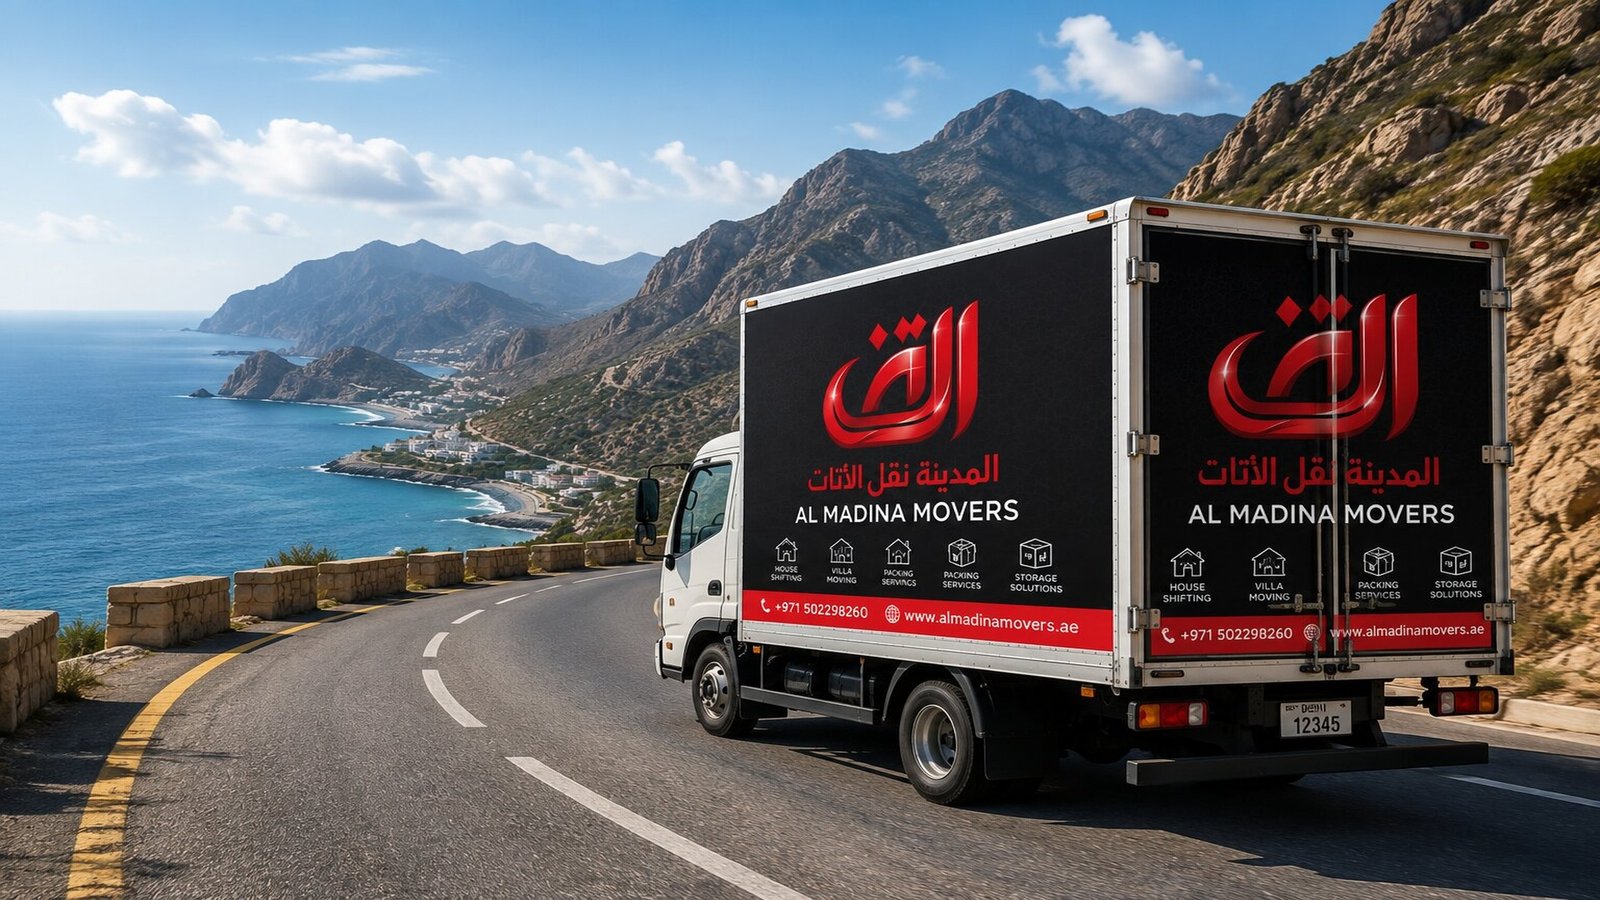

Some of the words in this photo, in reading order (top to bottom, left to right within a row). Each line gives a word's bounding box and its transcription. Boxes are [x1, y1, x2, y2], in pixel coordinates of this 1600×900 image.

[916, 453, 999, 493] المدينة
[1344, 456, 1440, 495] المدينة
[867, 462, 910, 497] نقل
[795, 506, 818, 524] AL
[823, 503, 906, 524] MADINA
[913, 499, 1019, 523] MOVERS
[1188, 504, 1222, 524] AL
[1230, 504, 1336, 524] MADINA
[1344, 504, 1456, 524] MOVERS
[774, 565, 799, 574] HOUSE
[831, 567, 853, 575] VILLA
[770, 573, 803, 582] SHIFTING
[826, 576, 857, 584] MOVING
[943, 571, 980, 580] PACKING
[1014, 573, 1058, 583] STORAGE
[942, 580, 982, 590] SERVICES
[1009, 583, 1063, 594] SOLUTIONS
[1169, 582, 1206, 592] HOUSE
[1254, 582, 1284, 591] VILLA
[1358, 581, 1399, 590] PACKING
[1434, 580, 1478, 589] STORAGE
[1162, 594, 1212, 603] SHIFTING
[1248, 592, 1291, 602] MOVING
[1354, 591, 1401, 600] SERVICES
[1430, 590, 1483, 599] SOLUTIONS
[775, 602, 800, 613] +971
[803, 602, 869, 619] 502298260
[904, 610, 1079, 634] www.almadinamovers.ae
[1180, 629, 1213, 641] +971
[1217, 627, 1293, 640] 502298260
[1329, 624, 1485, 638] www.almadinamovers.ae
[1293, 715, 1341, 734] 12345
